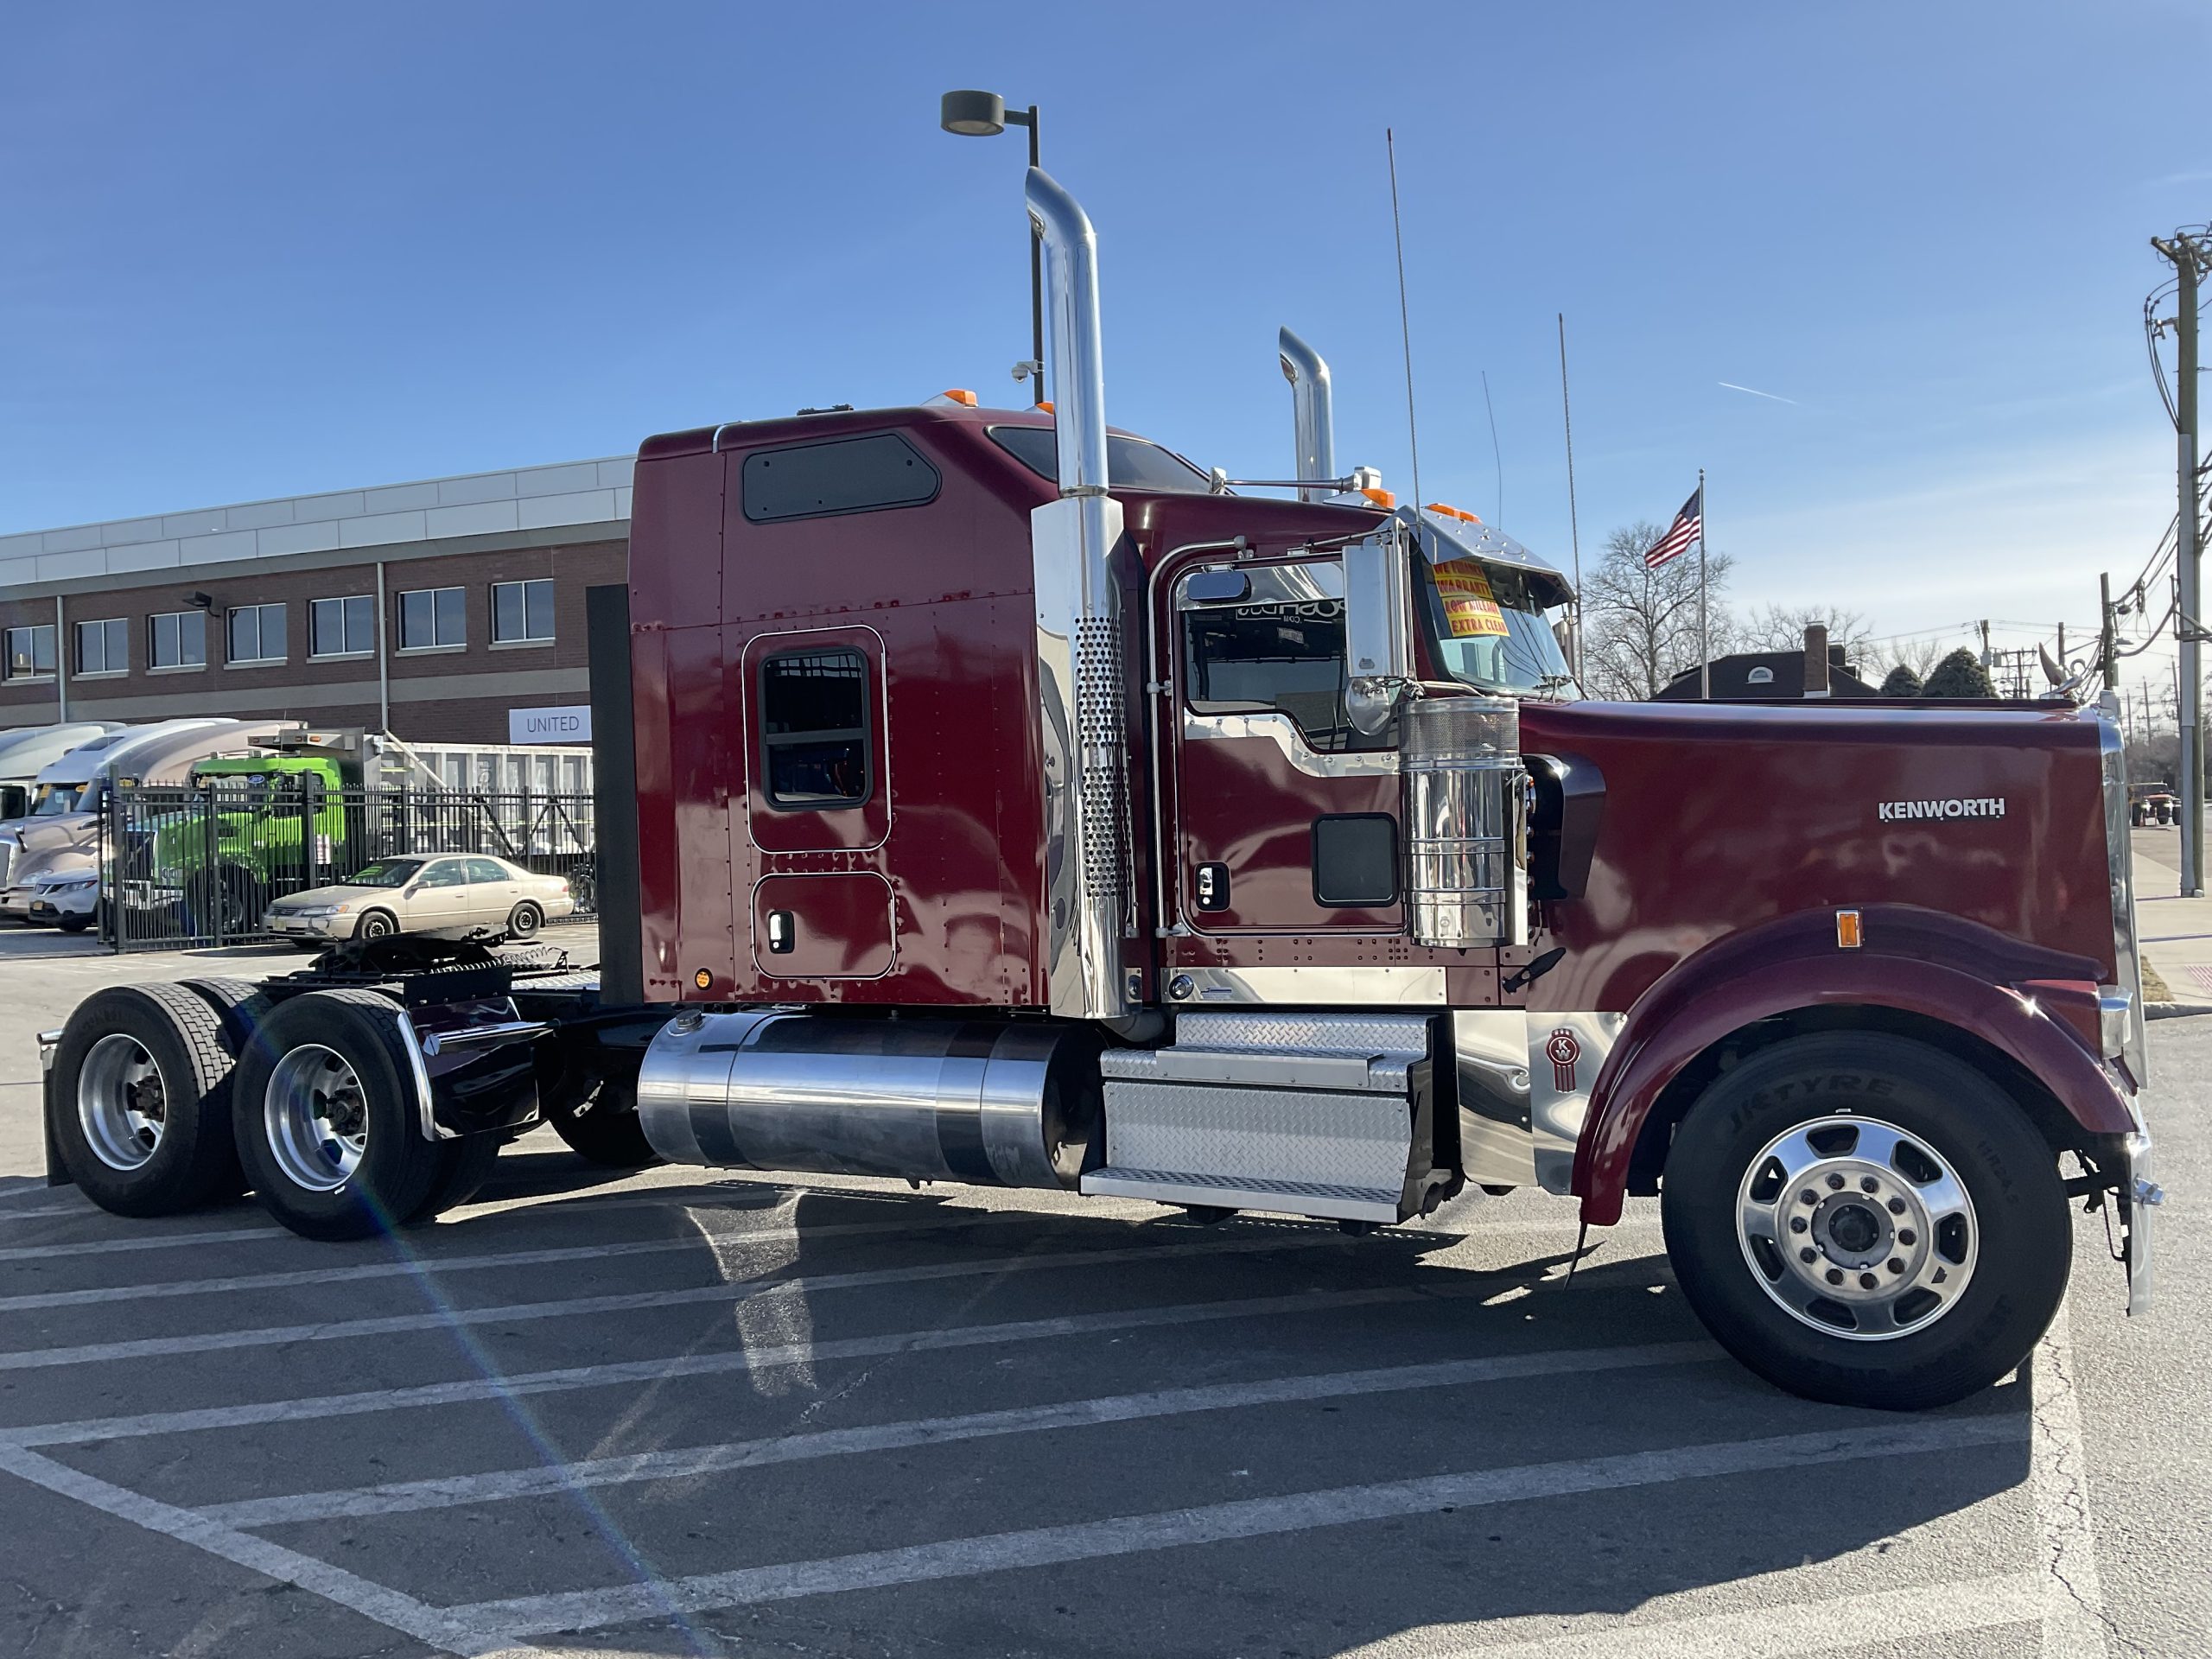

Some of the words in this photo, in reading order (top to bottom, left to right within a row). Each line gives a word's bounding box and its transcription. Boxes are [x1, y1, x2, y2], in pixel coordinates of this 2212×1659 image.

[1437, 580, 1491, 597] WARRANTY
[1445, 600, 1467, 614] LOW
[1452, 618, 1483, 633] EXTRA
[1485, 618, 1508, 633] CLEAN
[527, 715, 580, 733] UNITED
[1878, 798, 2005, 820] KENWORTH
